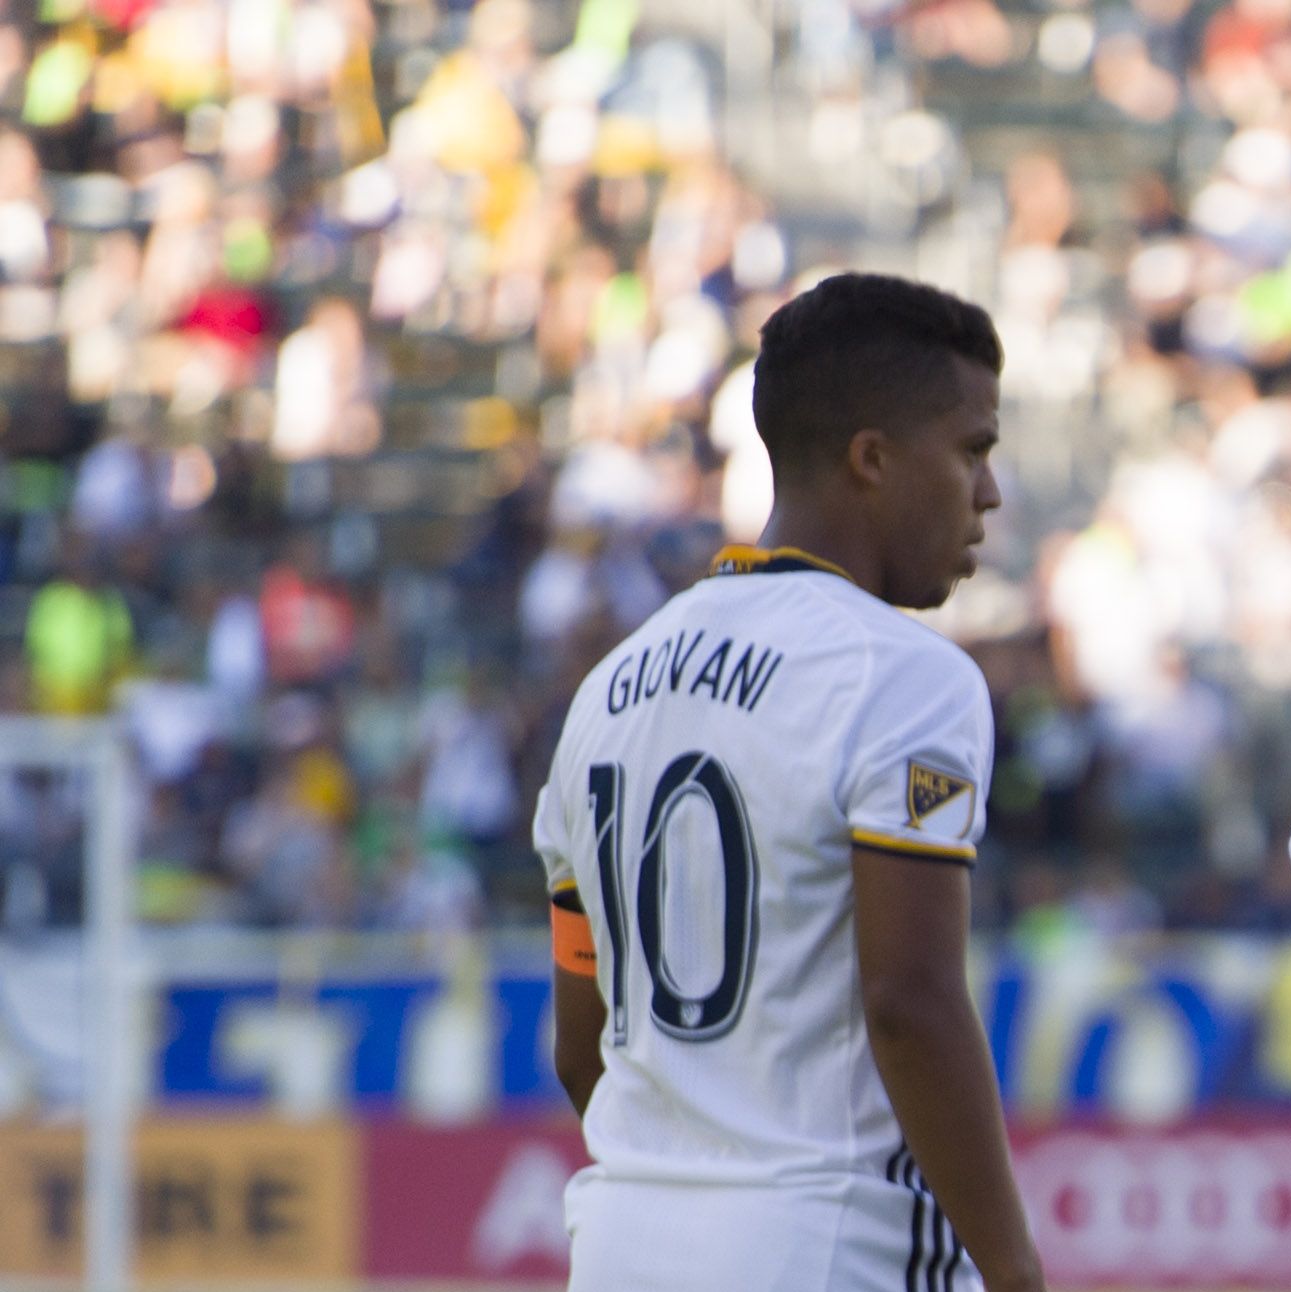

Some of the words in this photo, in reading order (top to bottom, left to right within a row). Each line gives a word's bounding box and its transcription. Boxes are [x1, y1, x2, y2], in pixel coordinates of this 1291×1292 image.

[607, 630, 784, 717] GIOVANI
[914, 767, 951, 797] MLS
[588, 751, 760, 1047] 10
[28, 1152, 304, 1241] TRE
